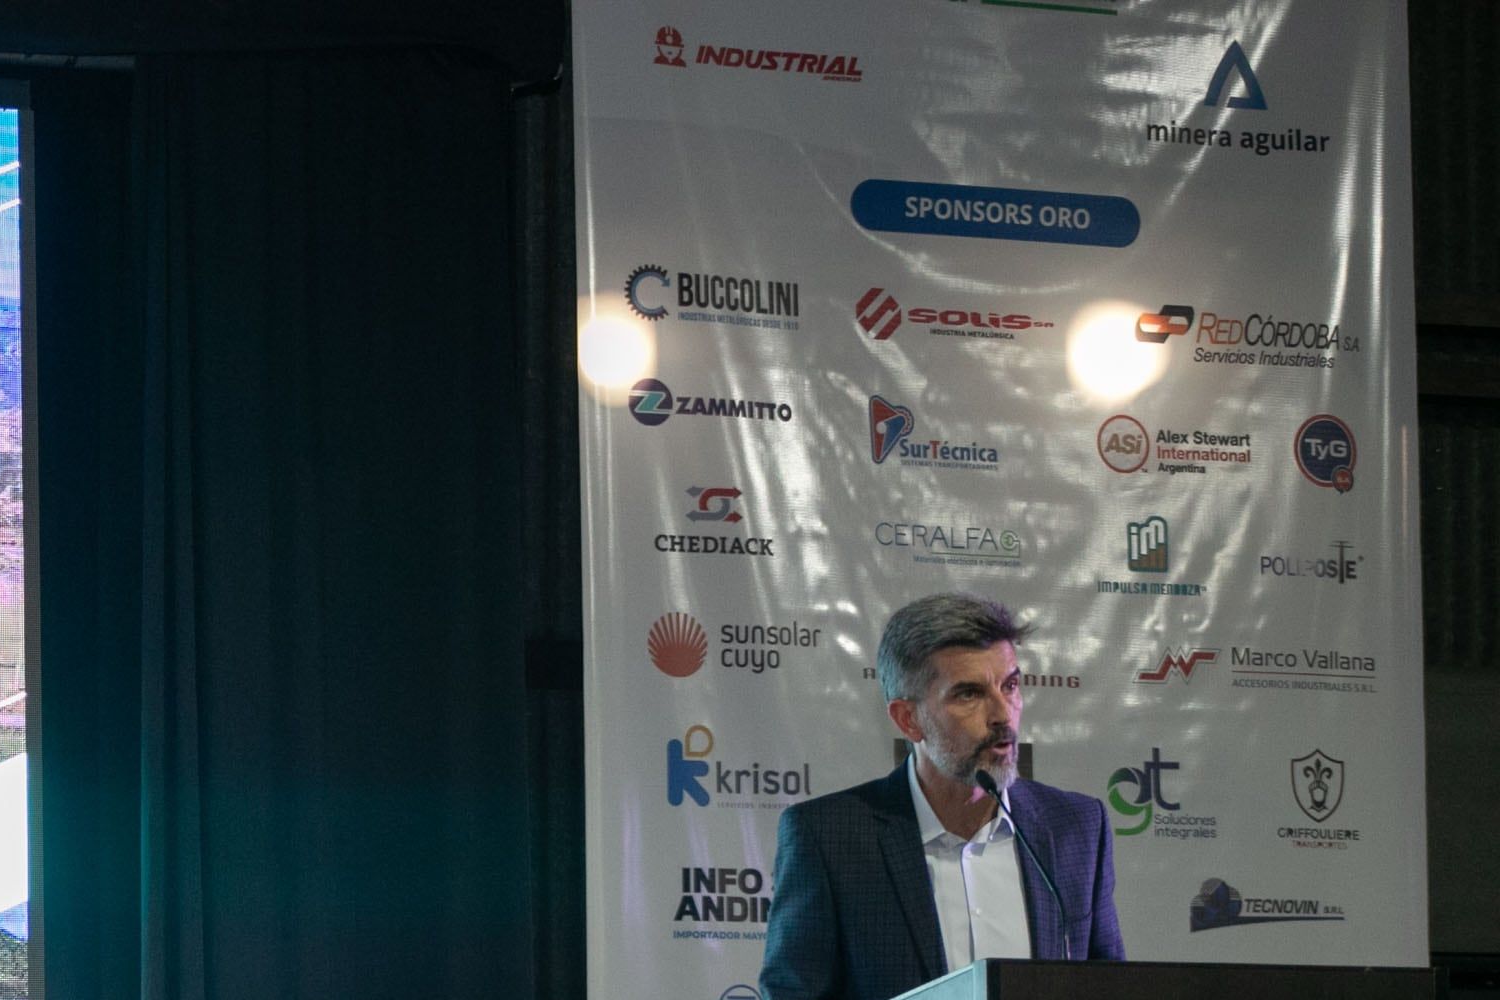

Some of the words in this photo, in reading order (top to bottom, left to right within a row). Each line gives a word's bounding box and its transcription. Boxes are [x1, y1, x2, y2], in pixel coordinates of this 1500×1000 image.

[695, 45, 863, 76] INDUSTRIAL
[1147, 120, 1232, 147] minera
[1240, 128, 1330, 156] aguilar
[904, 196, 1033, 225] SPONSORS
[1038, 205, 1092, 230] ORO
[677, 272, 799, 317] BUCCOLINI
[930, 328, 966, 338] INDUSTRIA
[1193, 347, 1256, 365] Servicios
[1259, 351, 1336, 369] Industriales
[675, 396, 793, 422] ZAMMITTO
[1156, 429, 1190, 444] Alex
[1193, 431, 1251, 447] Stewart
[1304, 438, 1348, 459] TyG
[900, 438, 998, 463] SurTécnica
[1156, 446, 1251, 463] International
[1157, 462, 1206, 474] Argentina
[654, 534, 774, 556] CHEDIACK
[721, 621, 821, 647] sunsolar
[721, 648, 780, 674] cuyo
[1231, 647, 1297, 668] Marco
[1303, 649, 1376, 672] Vallana
[1232, 679, 1290, 690] ACCESORIOS
[715, 761, 812, 796] krisol
[1154, 813, 1217, 826] Soluciones
[1154, 827, 1217, 840] integrales
[682, 867, 763, 894] INFO
[1244, 898, 1319, 915] TECNOVIN
[673, 930, 740, 940] IMPORTADOR
